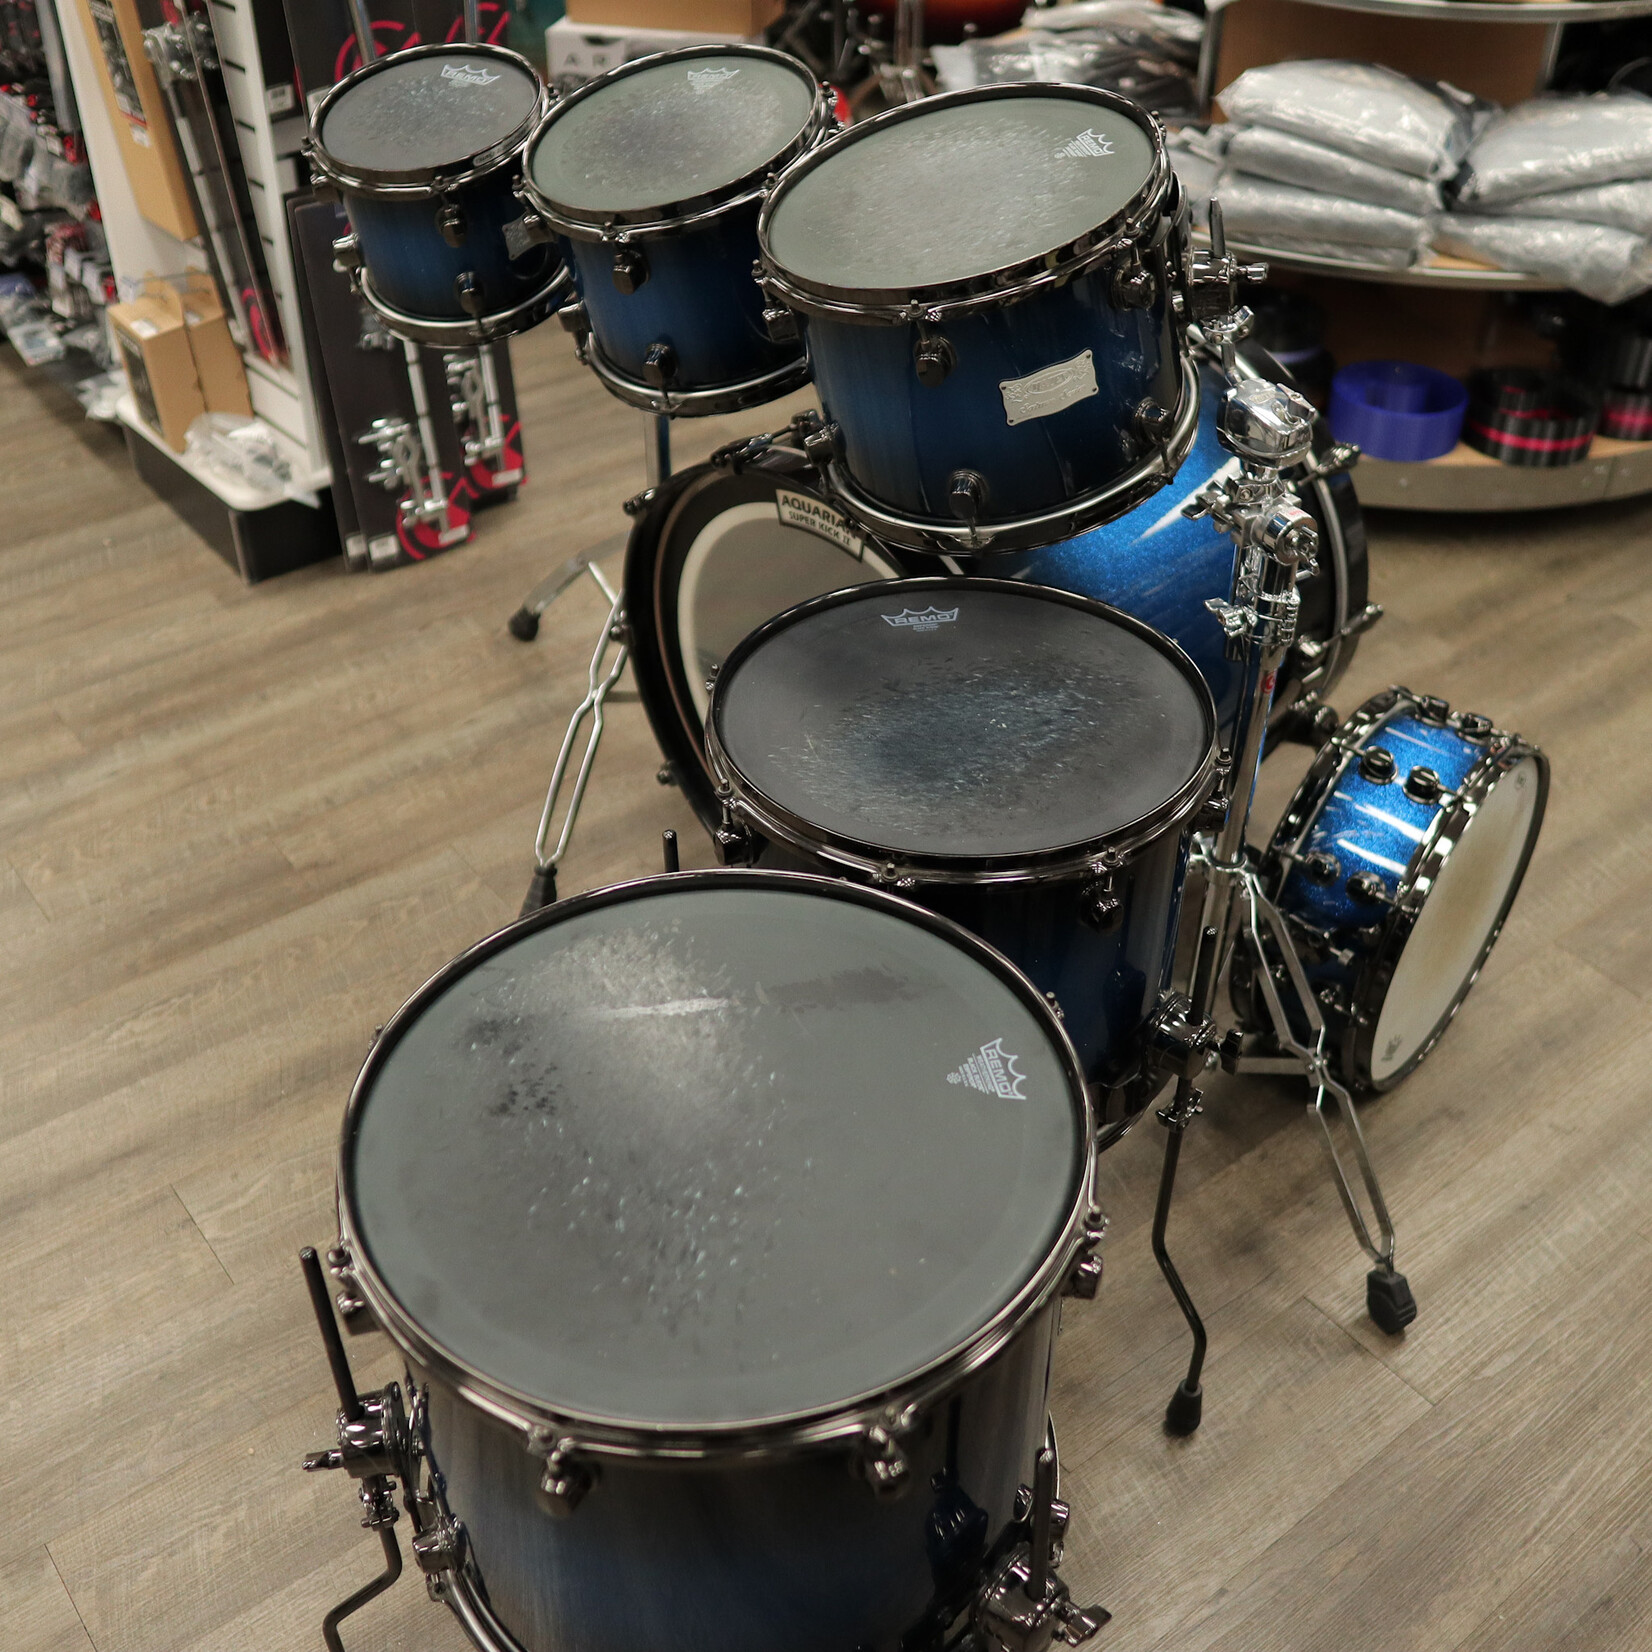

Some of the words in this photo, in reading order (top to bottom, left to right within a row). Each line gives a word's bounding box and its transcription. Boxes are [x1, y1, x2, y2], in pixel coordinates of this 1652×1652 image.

[446, 70, 487, 83] REMO
[1081, 134, 1103, 154] REMO
[789, 511, 817, 528] SUPER
[818, 523, 840, 539] KICK
[893, 613, 950, 625] REMO
[985, 1049, 1011, 1093] REMO
